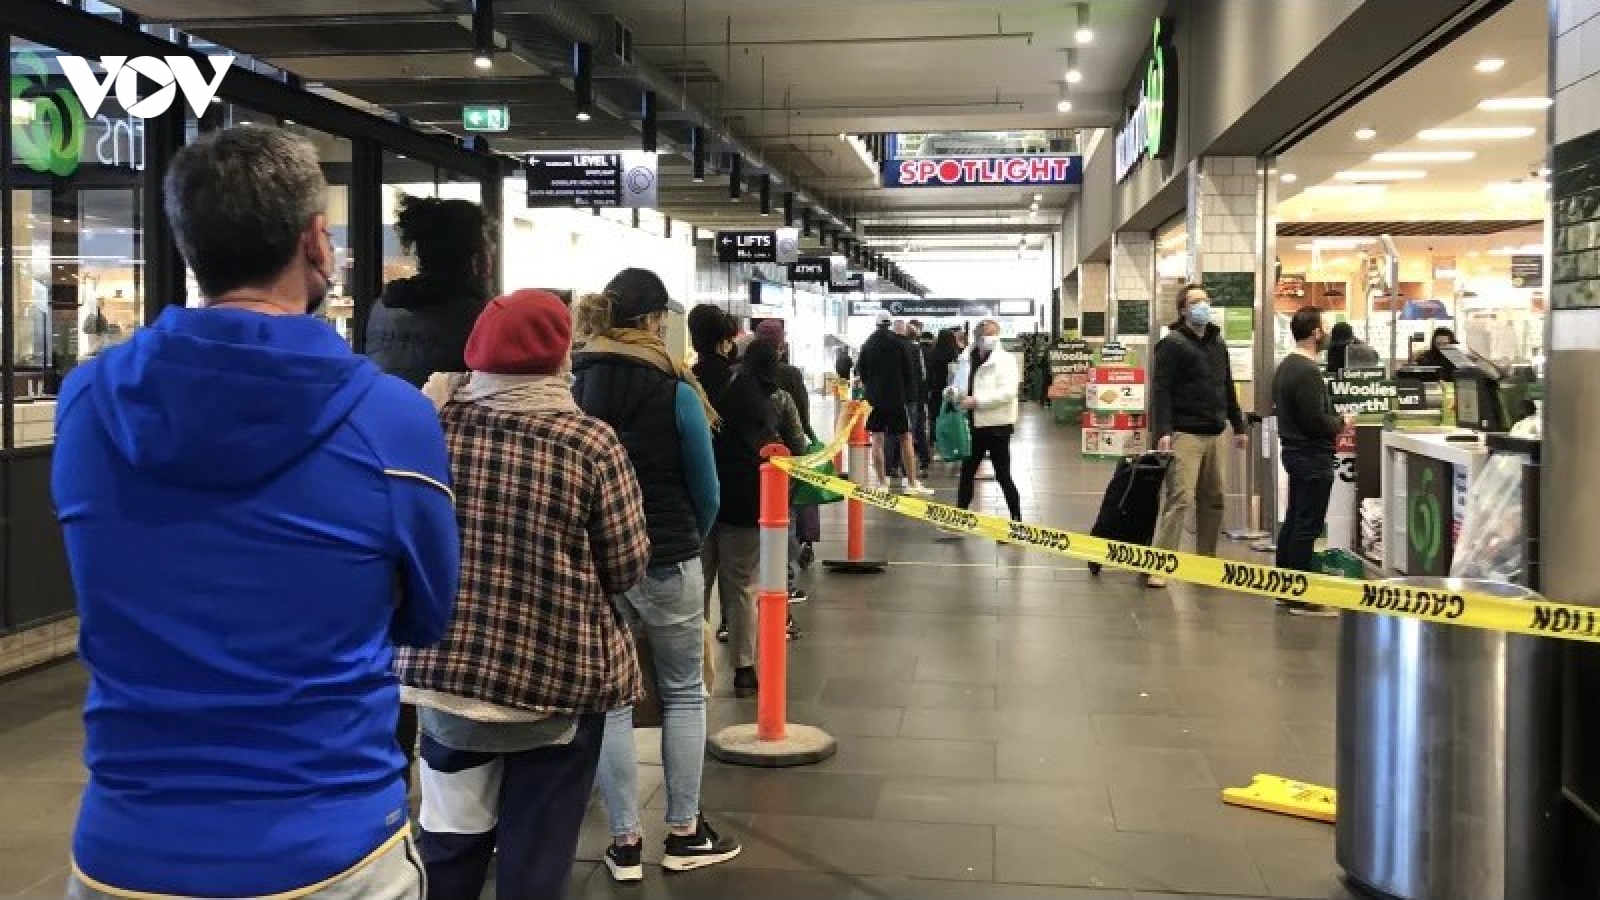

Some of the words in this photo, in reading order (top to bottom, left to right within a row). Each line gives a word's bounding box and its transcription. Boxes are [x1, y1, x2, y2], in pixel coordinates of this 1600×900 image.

[573, 155, 608, 166] LEVEL
[899, 157, 1070, 184] SPOTLIGHT
[736, 235, 771, 246] LIFTS
[1331, 381, 1397, 397] Woolies
[1106, 543, 1179, 574] CAUTION
[1222, 562, 1309, 596] CAUTION
[1360, 584, 1465, 618] CAUTION
